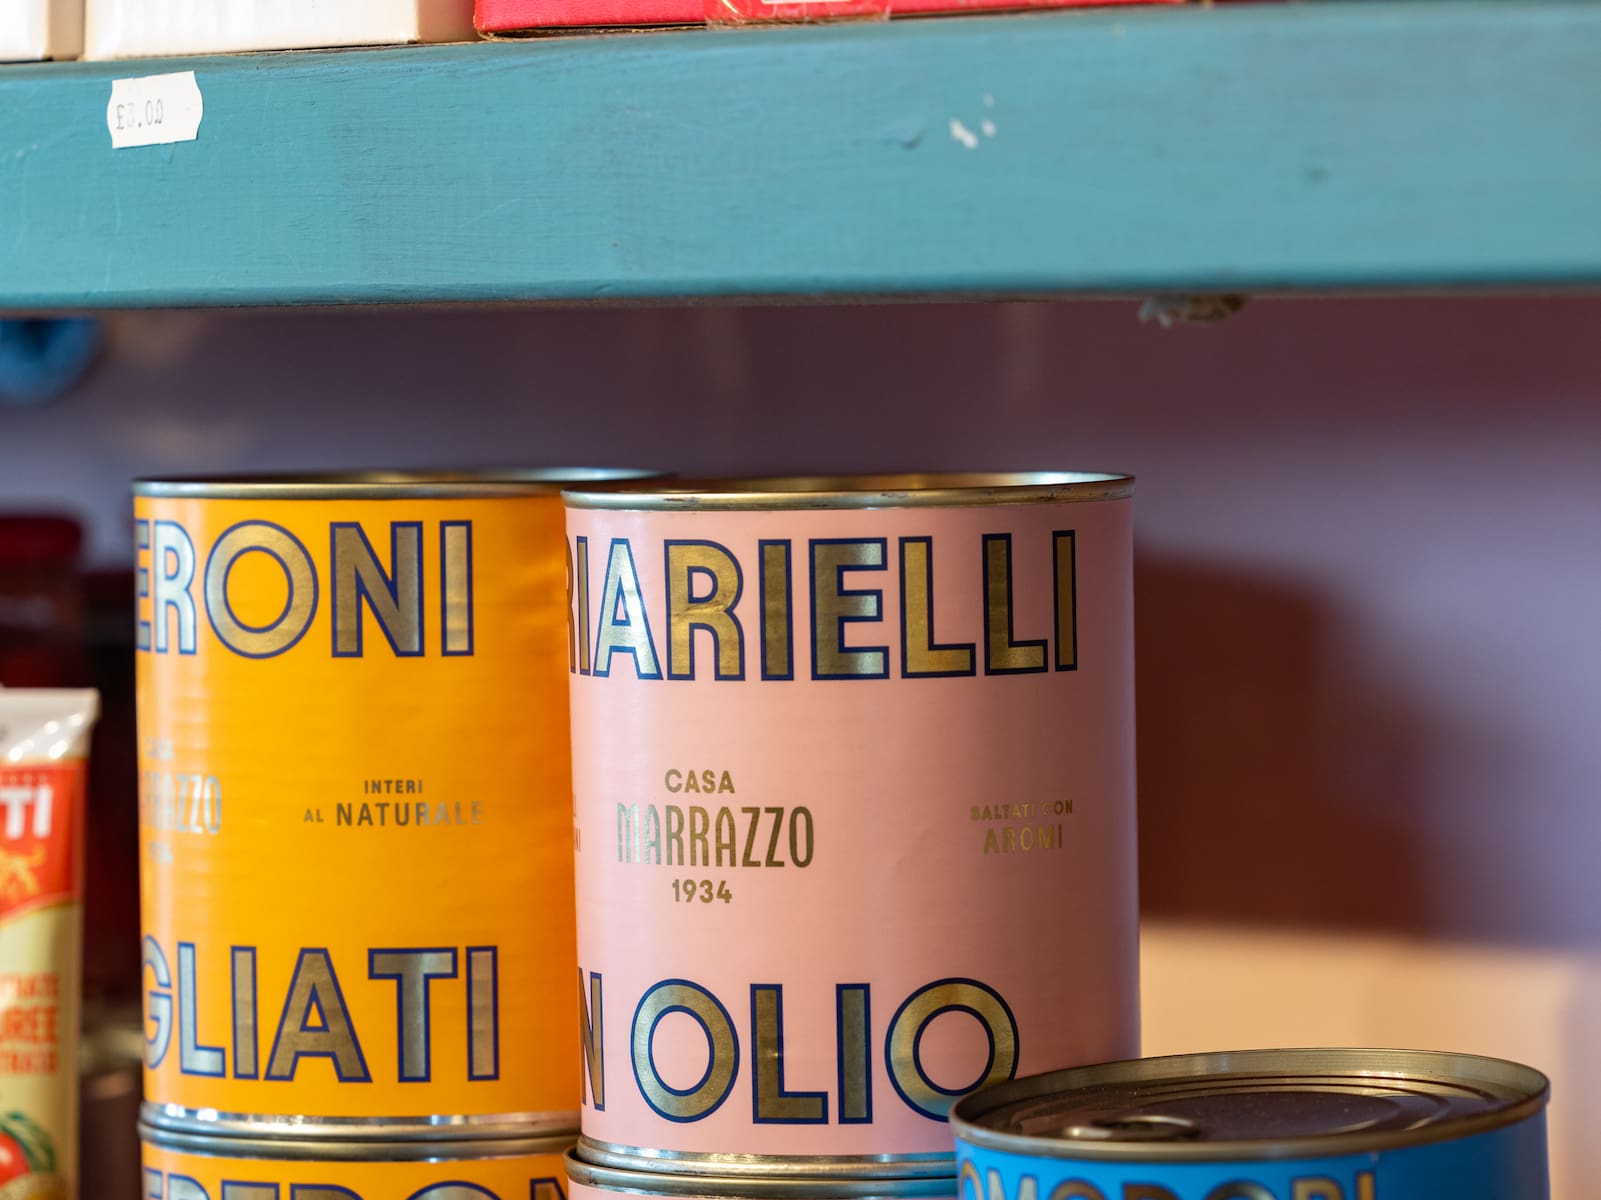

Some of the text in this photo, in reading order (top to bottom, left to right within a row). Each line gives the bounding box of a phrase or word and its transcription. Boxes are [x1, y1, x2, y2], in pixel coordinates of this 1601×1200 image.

[364, 779, 423, 795] INTERI
[664, 768, 736, 794] CASA
[304, 801, 485, 827] AL NATURALE
[616, 801, 814, 868] MARRAZZO
[983, 823, 1063, 854] AROMI
[672, 879, 733, 904] 1934
[143, 934, 500, 1083] GLIATI
[630, 977, 1020, 1124] OLIO
